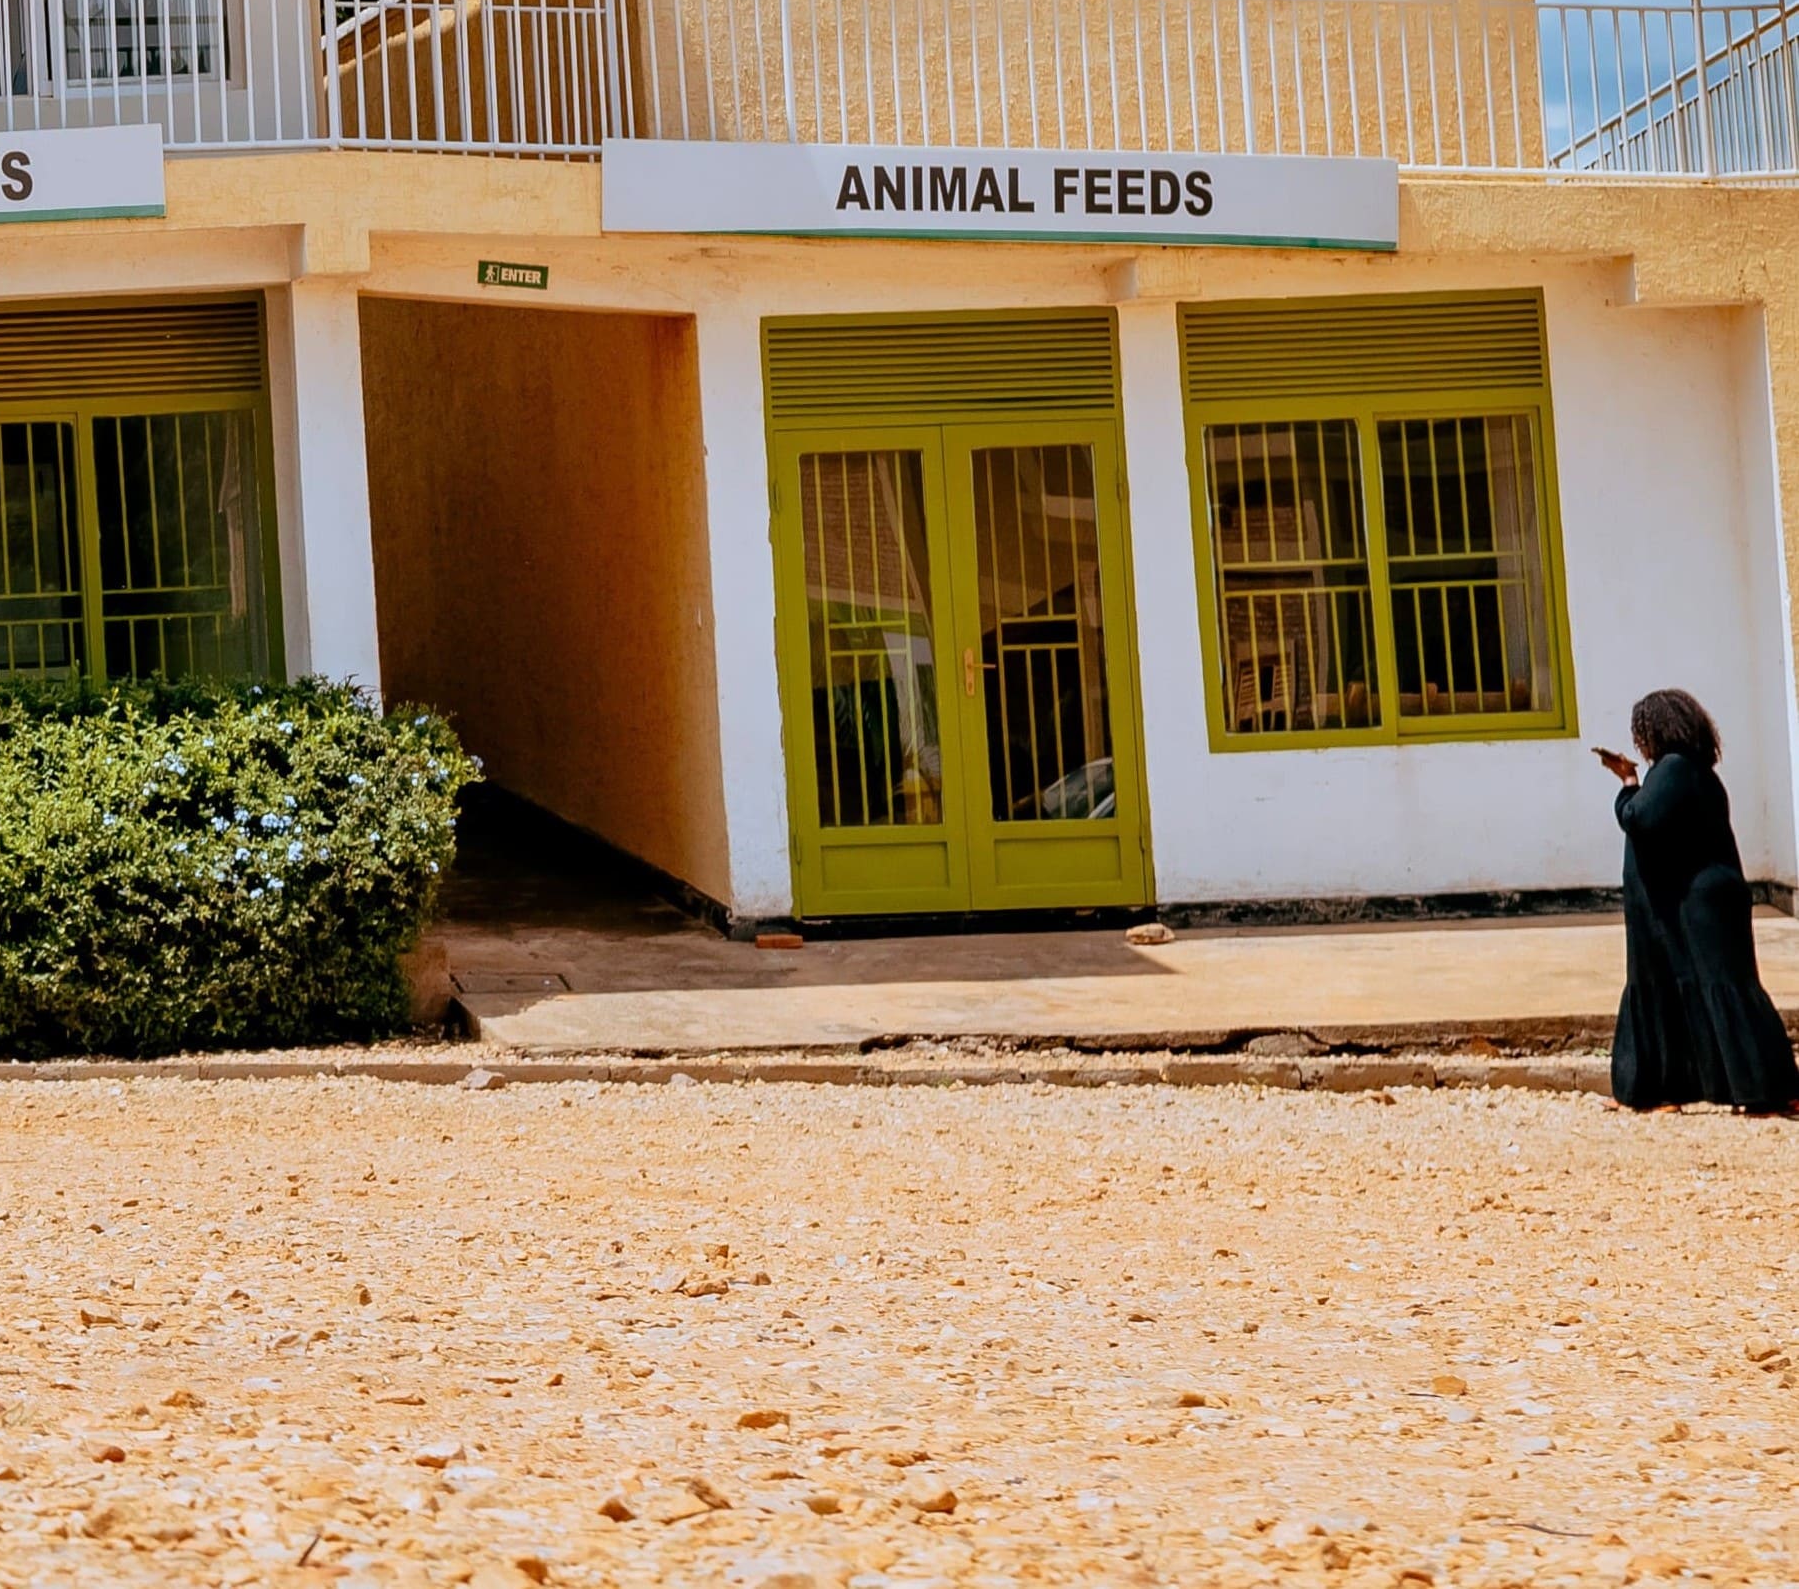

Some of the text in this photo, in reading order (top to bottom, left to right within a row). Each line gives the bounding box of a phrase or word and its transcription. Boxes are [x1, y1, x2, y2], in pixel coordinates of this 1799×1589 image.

[835, 164, 1214, 217] ANIMAL FEEDS
[501, 267, 541, 284] ENTER
